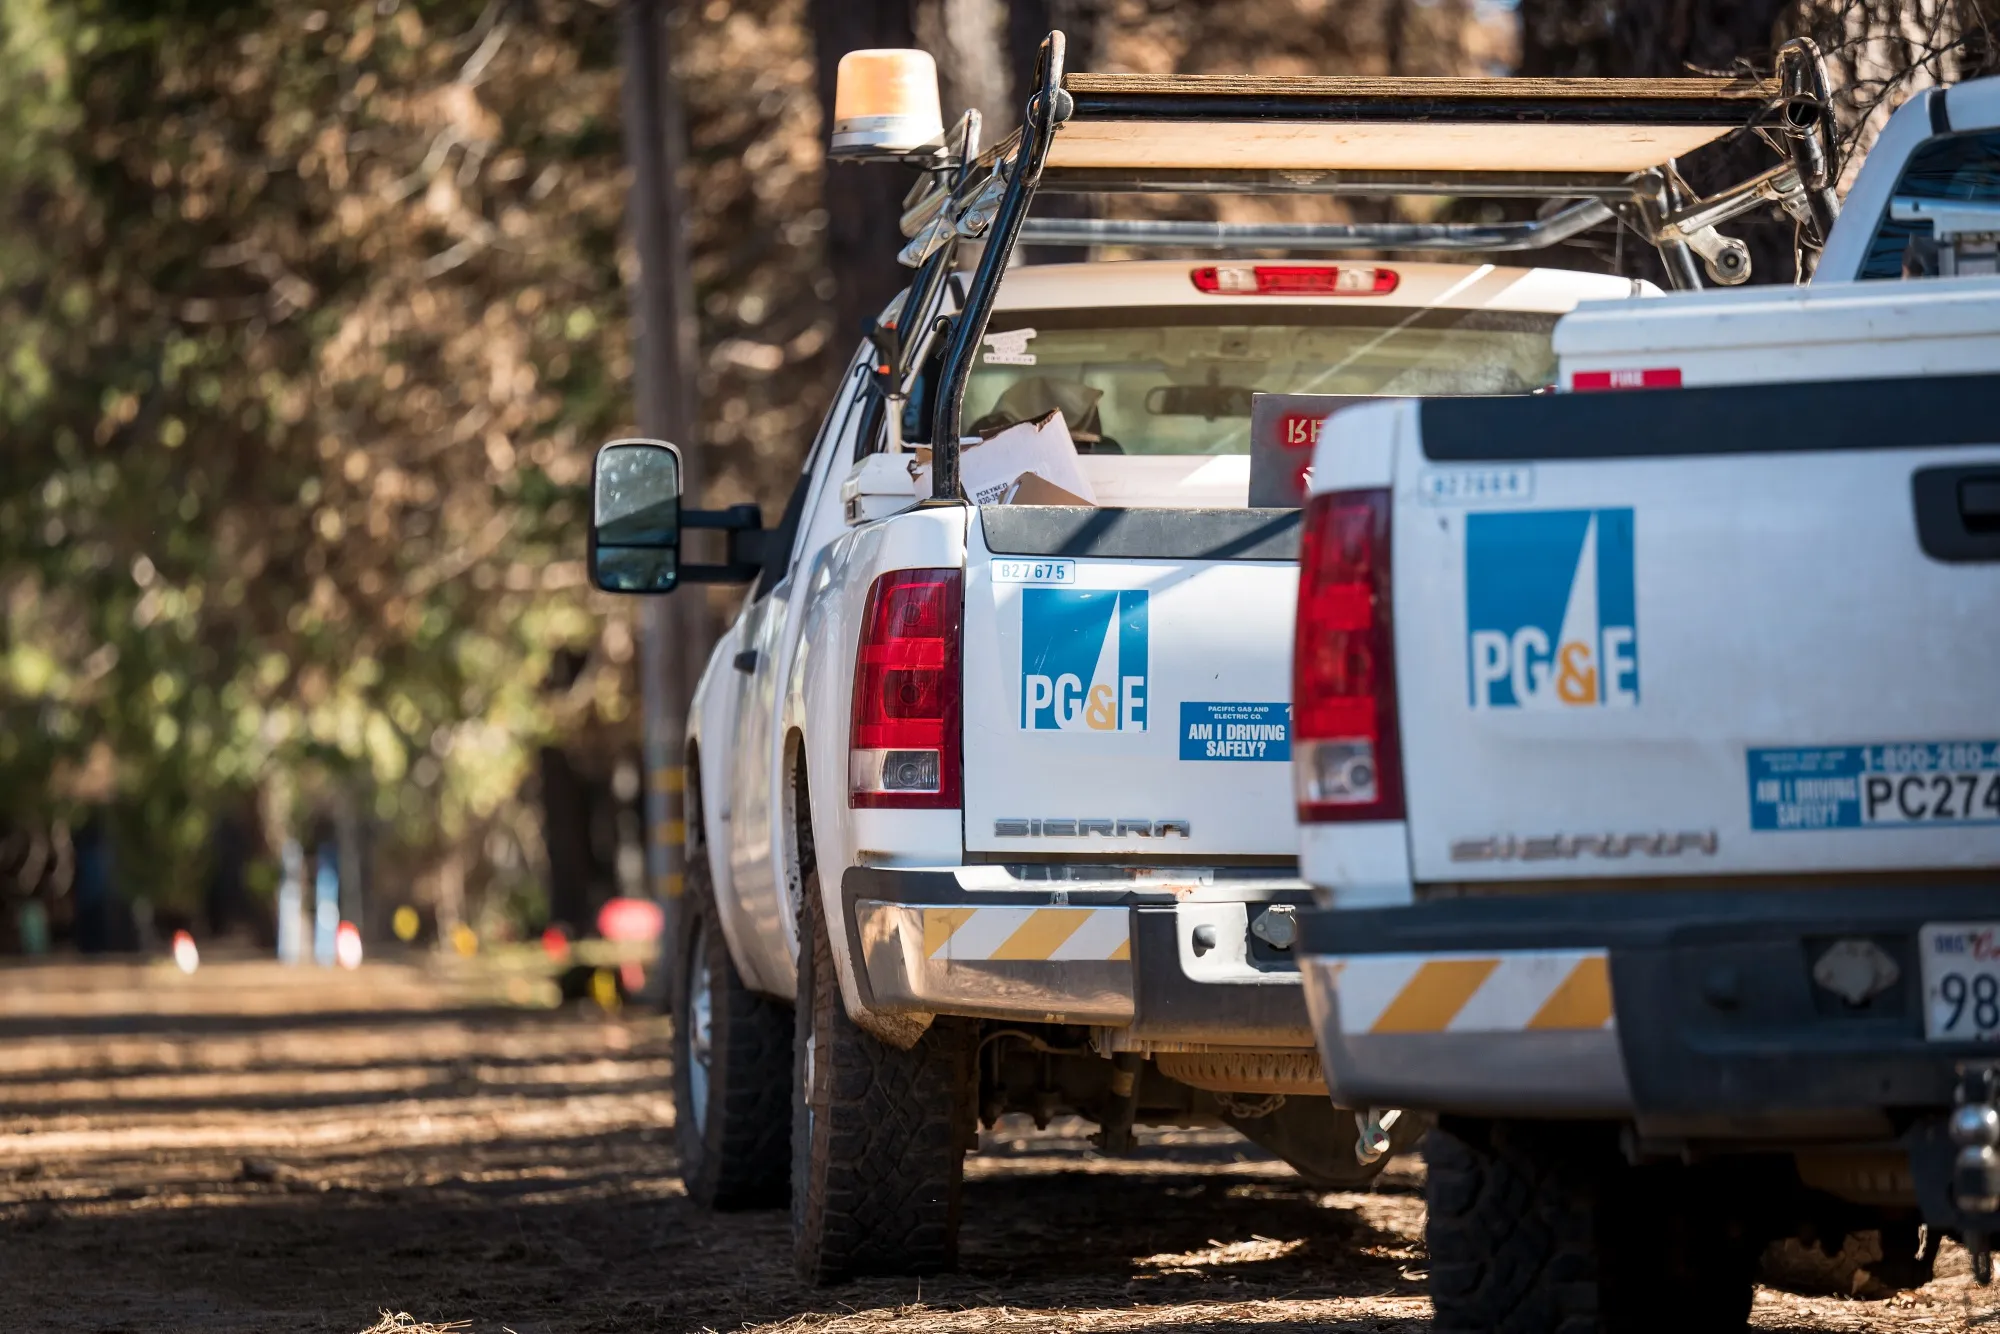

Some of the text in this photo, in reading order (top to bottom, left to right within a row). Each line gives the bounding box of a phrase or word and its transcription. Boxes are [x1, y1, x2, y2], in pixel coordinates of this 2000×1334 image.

[1473, 625, 1635, 709] PG&E
[1025, 672, 1145, 732] PG&E
[1208, 705, 1235, 713] PACIFIC
[1188, 723, 1286, 741] AM I DRIVING
[1206, 741, 1267, 757] SAFELY?
[994, 818, 1190, 840] SIERRA
